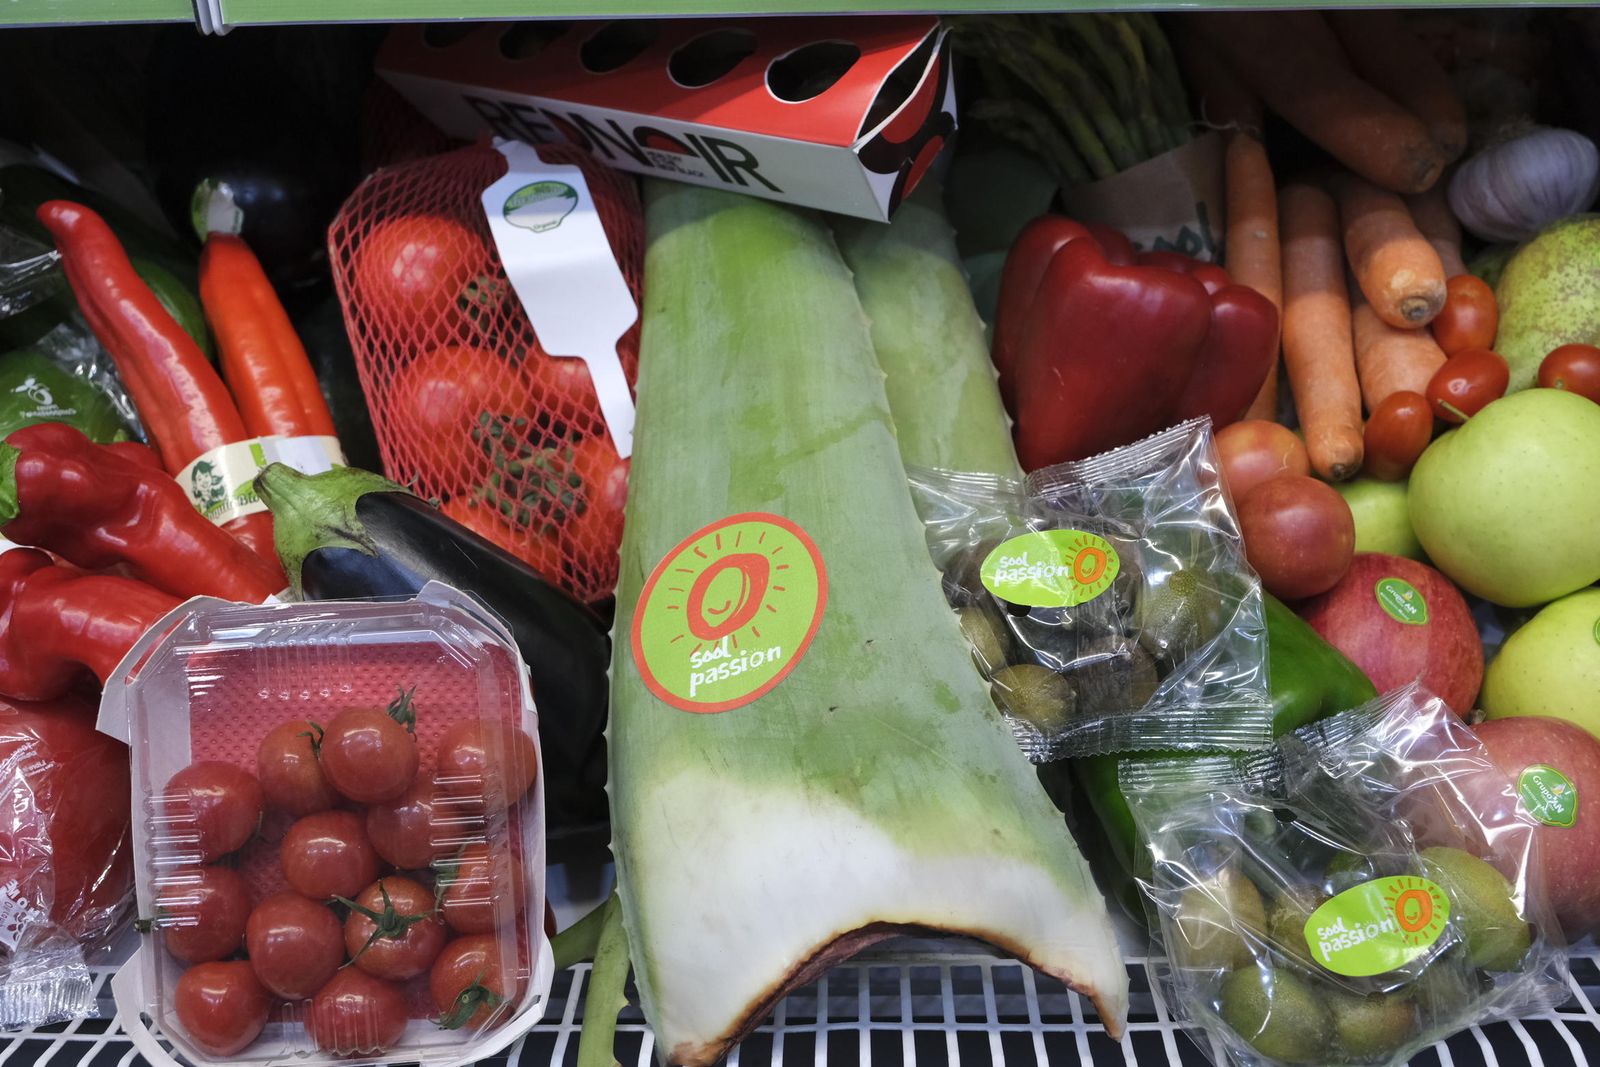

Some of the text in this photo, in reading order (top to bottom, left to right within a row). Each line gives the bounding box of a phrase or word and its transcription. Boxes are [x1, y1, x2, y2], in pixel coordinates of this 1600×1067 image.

[994, 560, 1068, 587] passion
[690, 646, 781, 697] passion
[1532, 775, 1554, 800] Grupo
[1318, 918, 1393, 962] passion
